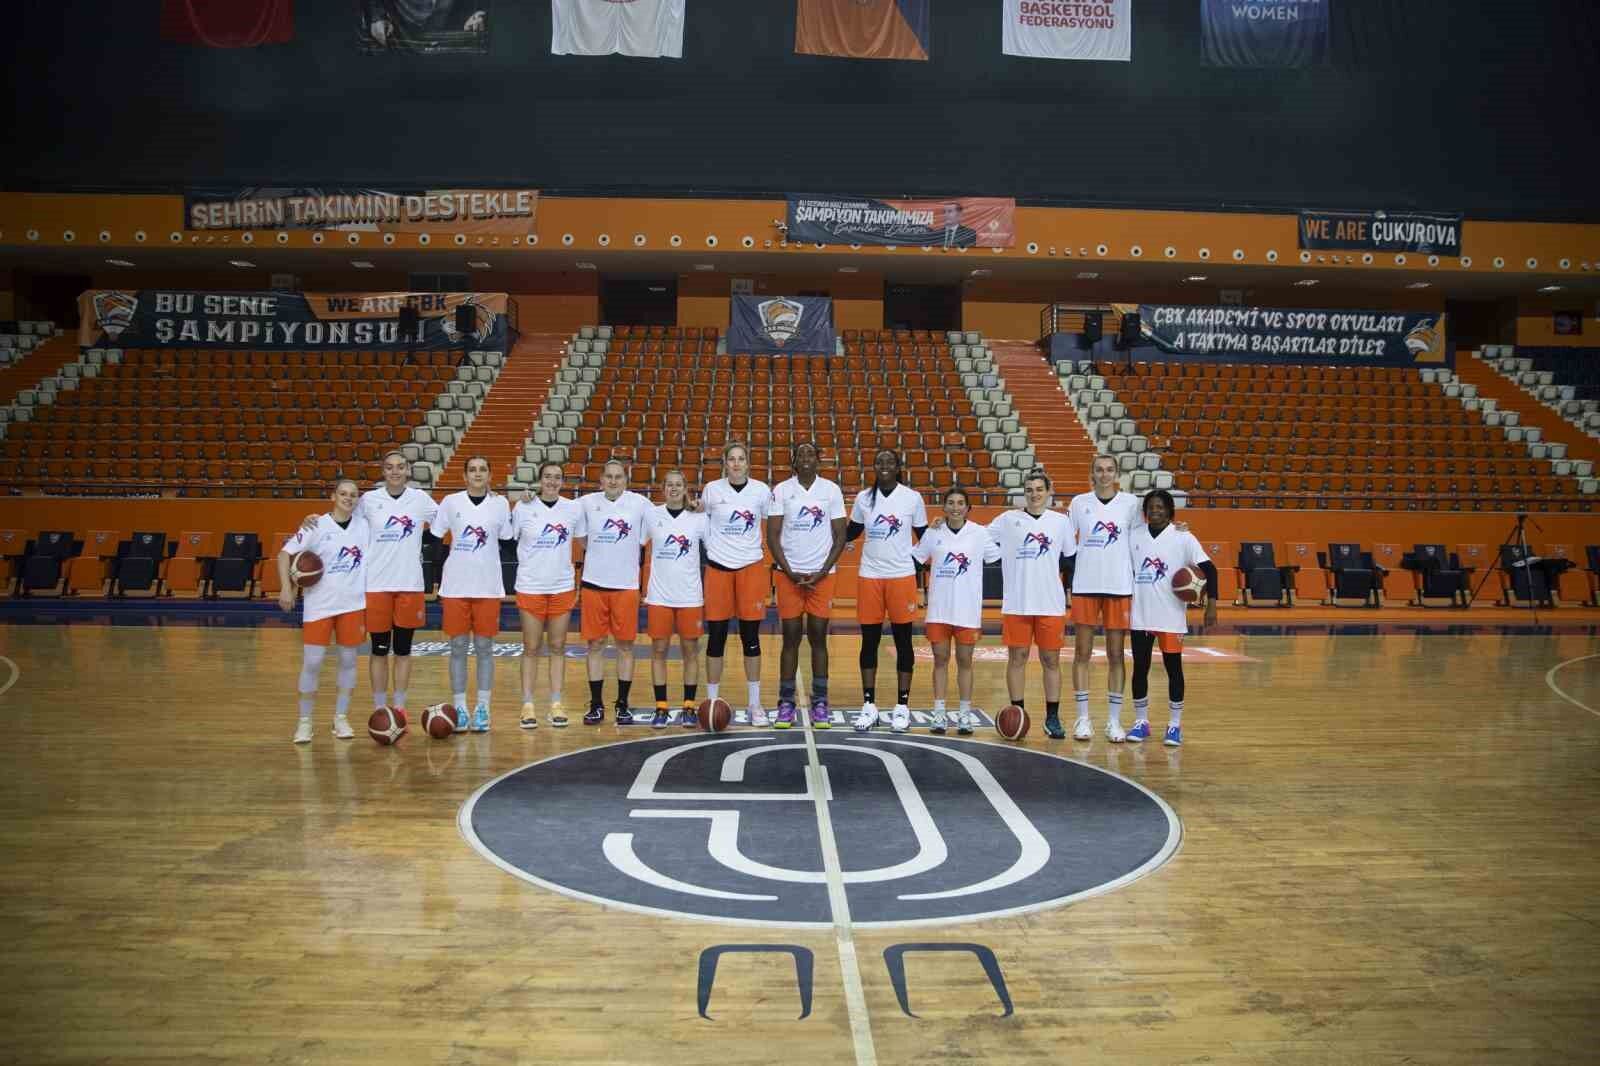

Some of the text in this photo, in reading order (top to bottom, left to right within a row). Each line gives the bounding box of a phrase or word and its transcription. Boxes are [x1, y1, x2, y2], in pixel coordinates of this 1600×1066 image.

[1020, 2, 1115, 17] BASKETBOL
[1231, 4, 1298, 20] WOMEN
[1019, 15, 1114, 29] FEDERASYONU
[288, 196, 400, 221] TAKIMINI
[406, 192, 530, 217] DESTEKLE
[863, 208, 934, 225] TAKIMIMIZA
[1305, 218, 1457, 246] WE ARE ÇUKUROVA
[155, 293, 195, 313] BU
[204, 295, 278, 316] SENE
[1153, 307, 1185, 328] ÇBK
[1260, 311, 1283, 328] VE
[1286, 312, 1327, 330] SPOR
[1173, 332, 1184, 349] A
